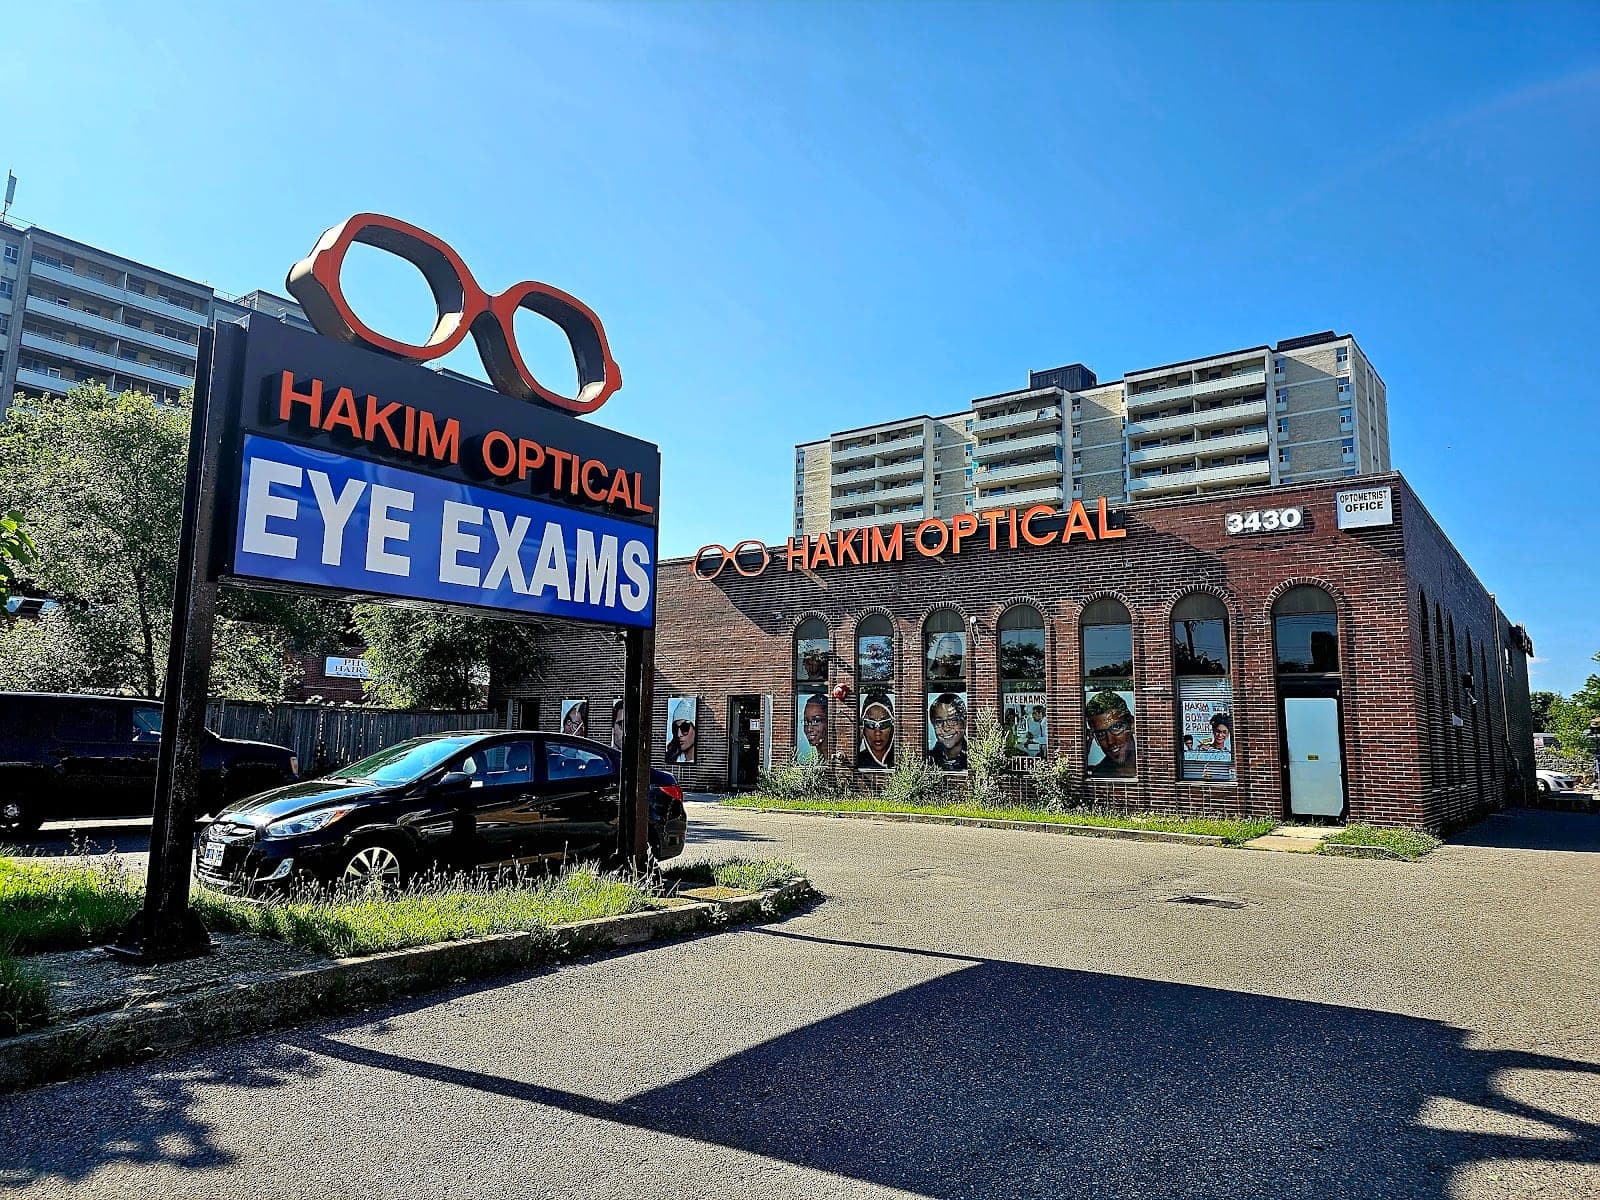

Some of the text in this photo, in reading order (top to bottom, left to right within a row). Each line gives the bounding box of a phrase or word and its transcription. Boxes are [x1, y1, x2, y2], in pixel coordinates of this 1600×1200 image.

[279, 370, 654, 513] HAKIM OPTICAL
[1339, 490, 1387, 503] OPTOMETRIST
[1345, 501, 1384, 512] OFFICE
[1227, 509, 1302, 533] 3430
[242, 456, 650, 612] EYE EXAMS
[787, 496, 1127, 571] HAKIM OPTICAL
[1005, 695, 1046, 704] EYE EXAMS
[1184, 702, 1209, 711] HAKIM
